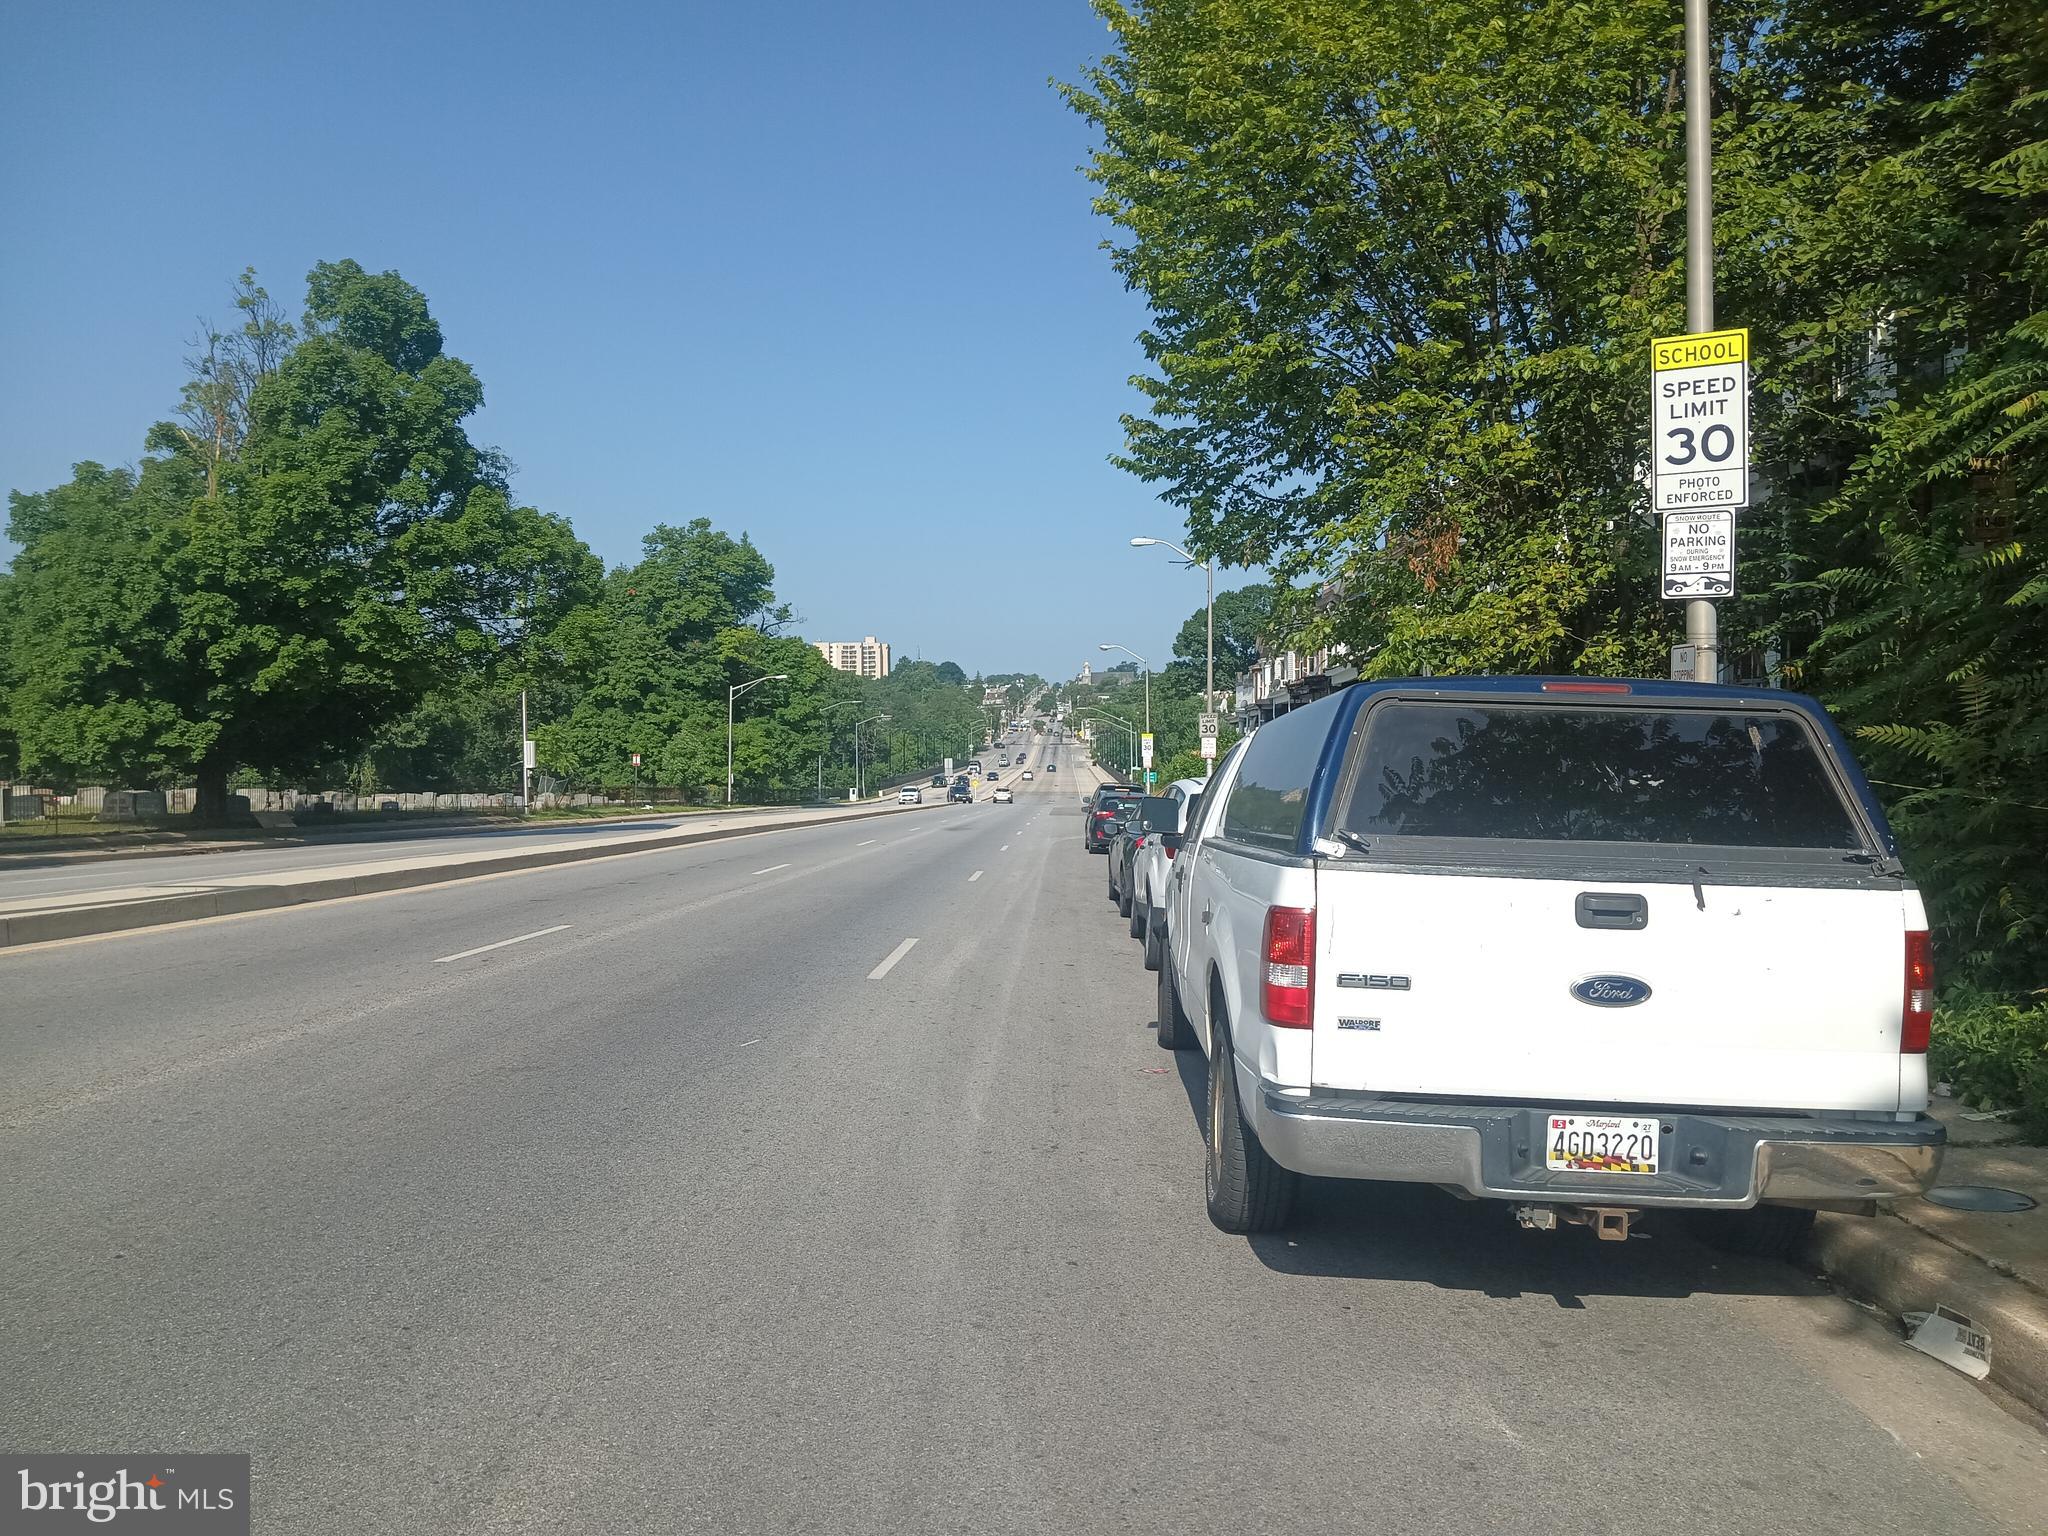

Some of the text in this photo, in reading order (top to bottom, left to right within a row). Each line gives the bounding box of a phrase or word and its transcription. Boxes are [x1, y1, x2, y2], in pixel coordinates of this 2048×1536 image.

[1659, 342, 1739, 365] SCHOOL
[1663, 376, 1736, 398] SPEED
[1670, 399, 1728, 420] LIMIT
[1665, 423, 1734, 466] 30
[1679, 476, 1720, 489] PHOTO
[1666, 489, 1733, 504] ENFORCED
[1688, 523, 1709, 534] NO
[1670, 535, 1726, 547] PARKING
[1670, 563, 1677, 572] 9
[1703, 562, 1709, 570] 9
[1680, 651, 1687, 663] NO
[1201, 724, 1216, 733] 30
[1339, 973, 1409, 988] F-150
[1589, 981, 1634, 999] Ford
[1338, 1018, 1380, 1028] WALDORF
[1586, 1119, 1621, 1130] Maryland
[1553, 1131, 1652, 1161] 4GD3220
